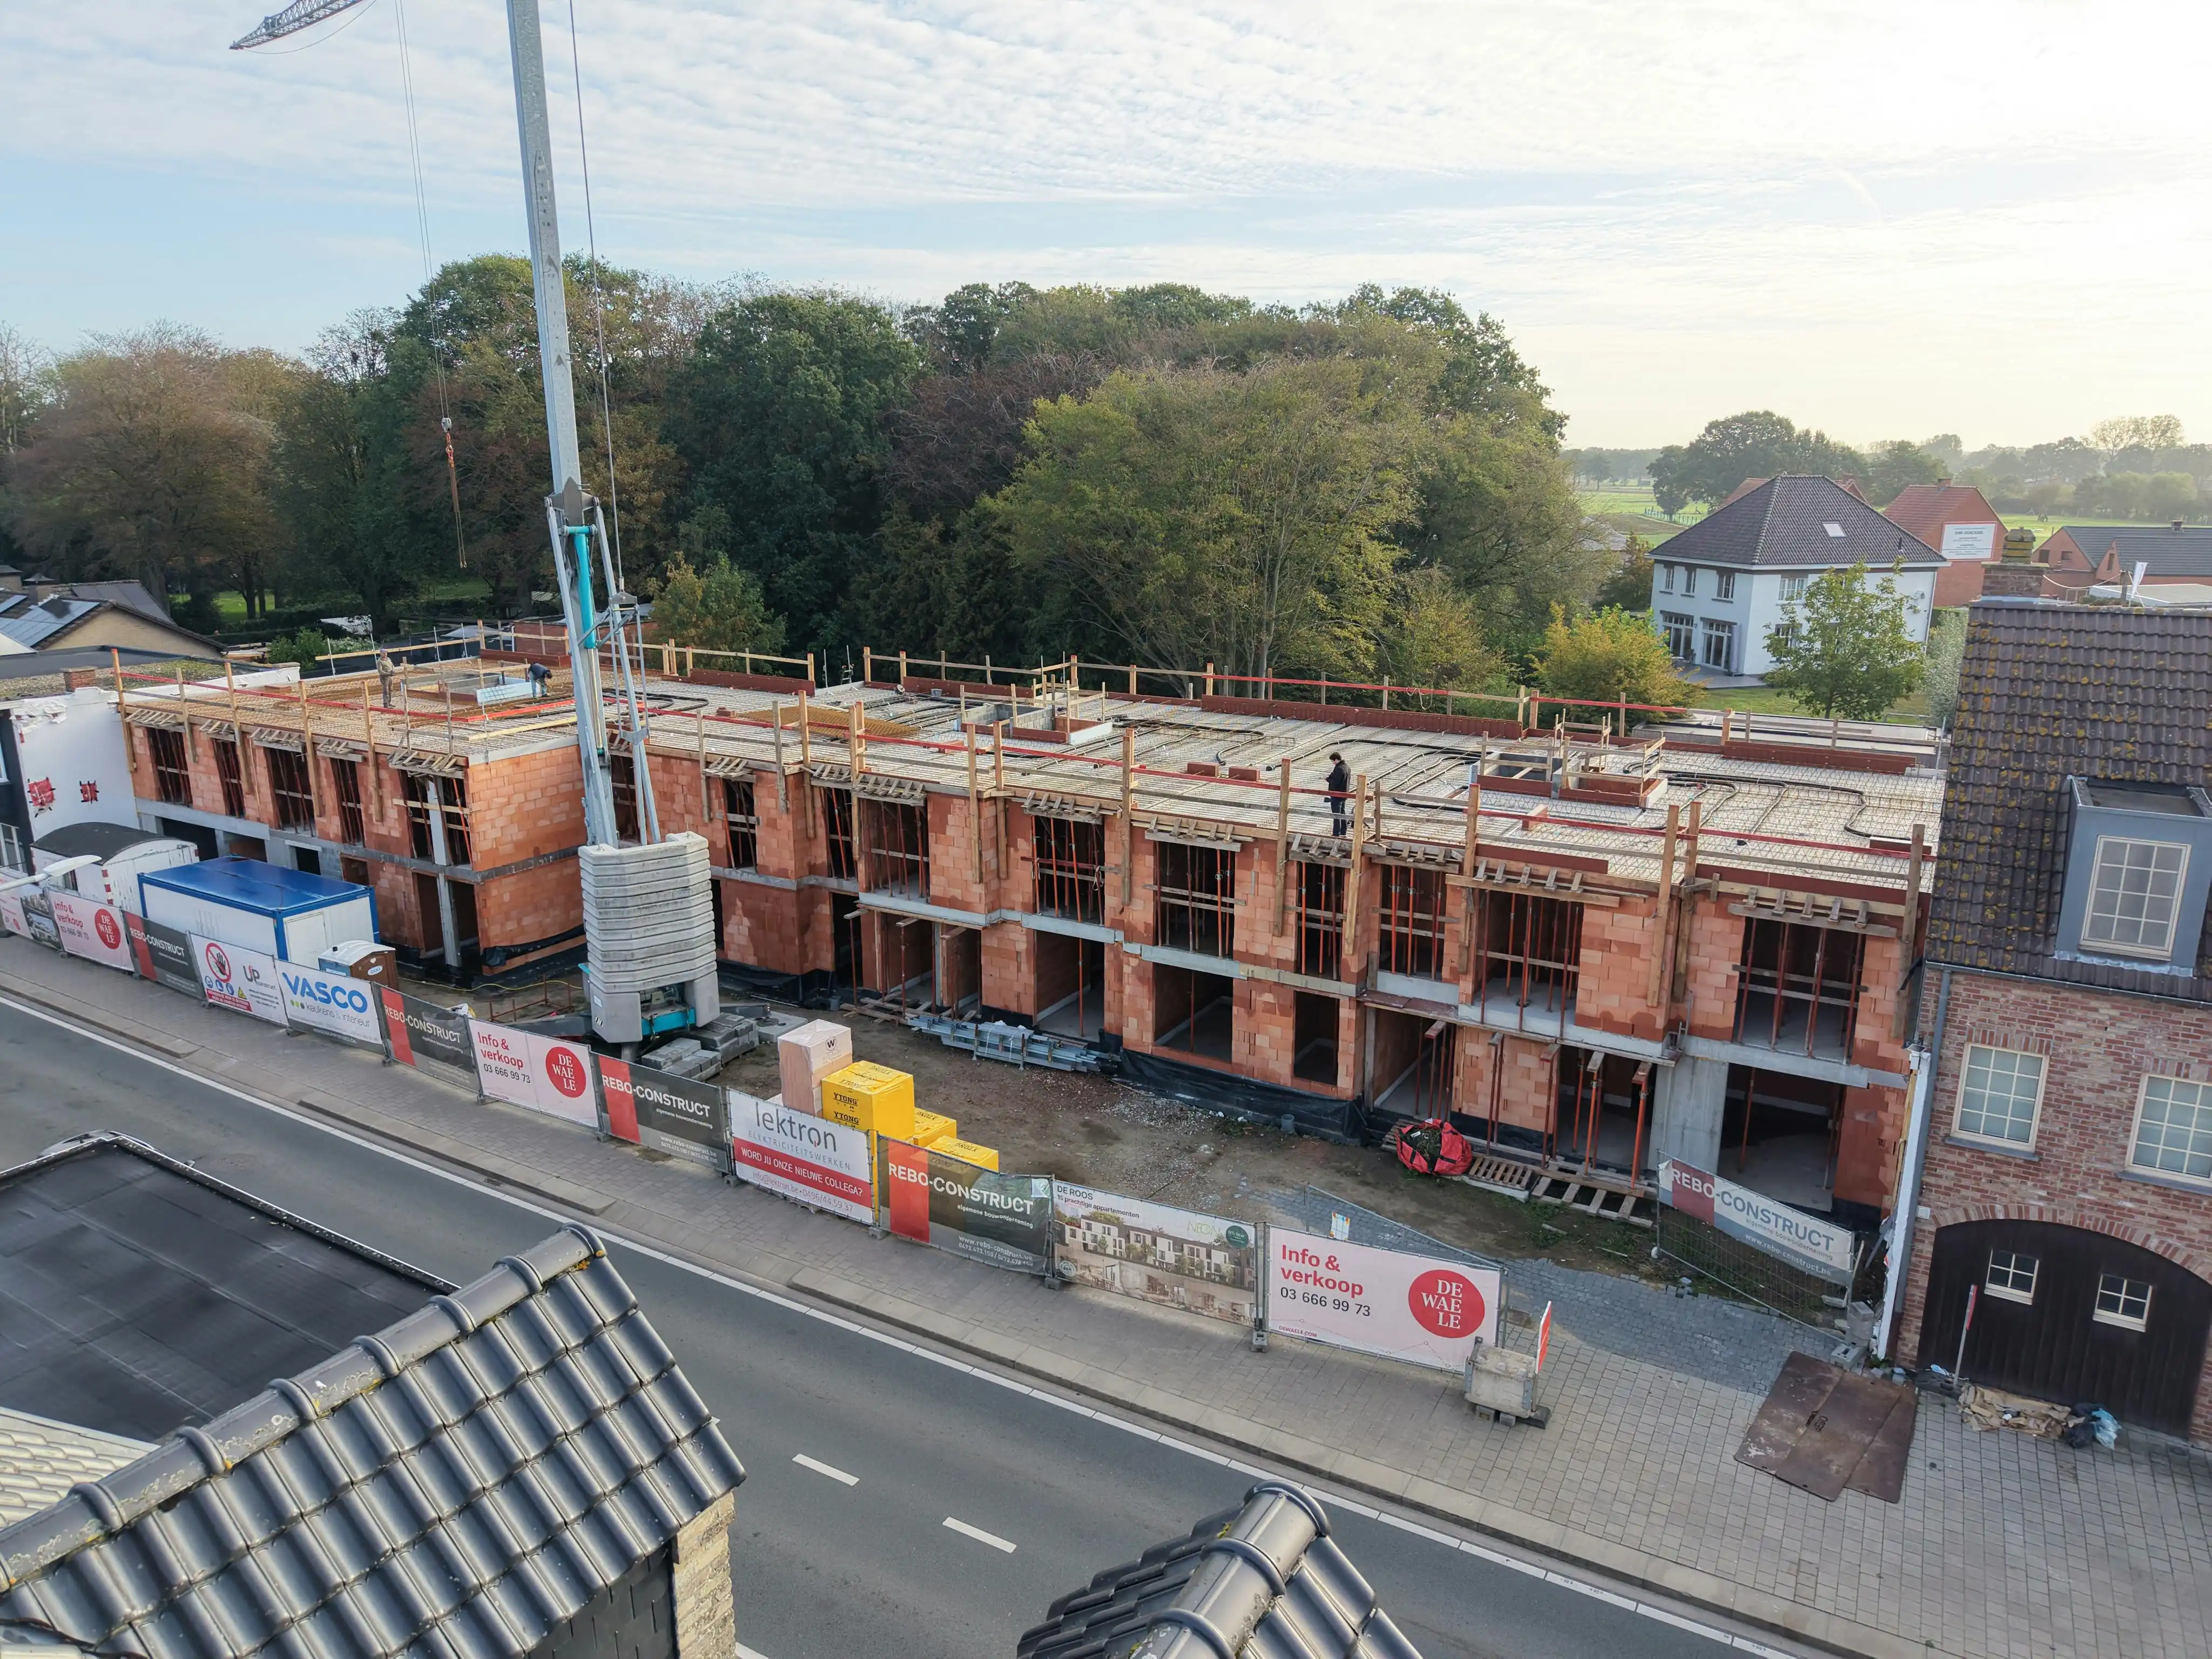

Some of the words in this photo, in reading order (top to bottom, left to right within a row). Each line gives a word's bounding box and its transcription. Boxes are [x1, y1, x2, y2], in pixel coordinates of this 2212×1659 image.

[55, 900, 68, 912] Info
[68, 905, 73, 914] &
[57, 914, 83, 929] verkoop
[99, 923, 113, 935] WAE
[101, 915, 111, 925] DE
[106, 934, 116, 944] LE
[130, 927, 185, 957] REBO-CONSTRUCT
[282, 972, 368, 1013] VASCO
[306, 1002, 335, 1019] keukens
[342, 1013, 369, 1028] interieur
[384, 1004, 460, 1043] REBO-CONSTRUCT
[478, 1032, 498, 1048] Info
[501, 1038, 509, 1051] &
[827, 1038, 835, 1048] W
[481, 1048, 523, 1070] verkoop
[558, 1054, 572, 1067] DE
[484, 1063, 493, 1073] 03
[495, 1067, 508, 1077] 666
[510, 1070, 520, 1080] 99
[521, 1074, 531, 1083] 73
[552, 1064, 574, 1079] WAE
[563, 1078, 576, 1091] LE
[602, 1074, 710, 1117] REBO-CONSTRUCT
[833, 1091, 857, 1105] YTONG
[756, 1101, 837, 1152] lektron
[834, 1111, 859, 1124] YTONG
[748, 1130, 850, 1171] ELEKTRICITEITSWERKEN
[741, 1147, 762, 1162] WORD
[773, 1159, 793, 1172] ONZE
[795, 1166, 823, 1183] NIEUWE
[825, 1176, 863, 1197] COLLEGA?
[888, 1162, 1034, 1215] REBO-CONSTRUCT
[1057, 1185, 1068, 1195] DE
[1070, 1188, 1093, 1201] ROOS
[957, 1203, 983, 1216] algemene
[984, 1210, 1033, 1229] bouwonderneming
[1064, 1197, 1092, 1208] prachtige
[1093, 1204, 1139, 1218] appartementen
[1672, 1169, 1834, 1251] REBO-CONSTRUCT
[1188, 1220, 1221, 1236] NEON
[1745, 1217, 1773, 1235] algemene
[1776, 1231, 1833, 1261] bouwonderneming
[959, 1242, 994, 1258] 0473.473.100
[1282, 1244, 1320, 1267] Info
[1325, 1255, 1340, 1272] &
[1745, 1233, 1832, 1277] www.rebo-construct.be
[1280, 1267, 1363, 1299] verkoop
[1437, 1279, 1463, 1298] DE
[1280, 1287, 1296, 1300] 03
[1302, 1292, 1327, 1307] 666
[1333, 1299, 1349, 1312] 99
[1354, 1303, 1371, 1317] 73
[1421, 1292, 1461, 1313] WAE
[1437, 1312, 1461, 1329] LE
[1279, 1325, 1317, 1338] DEWAELE.COM
